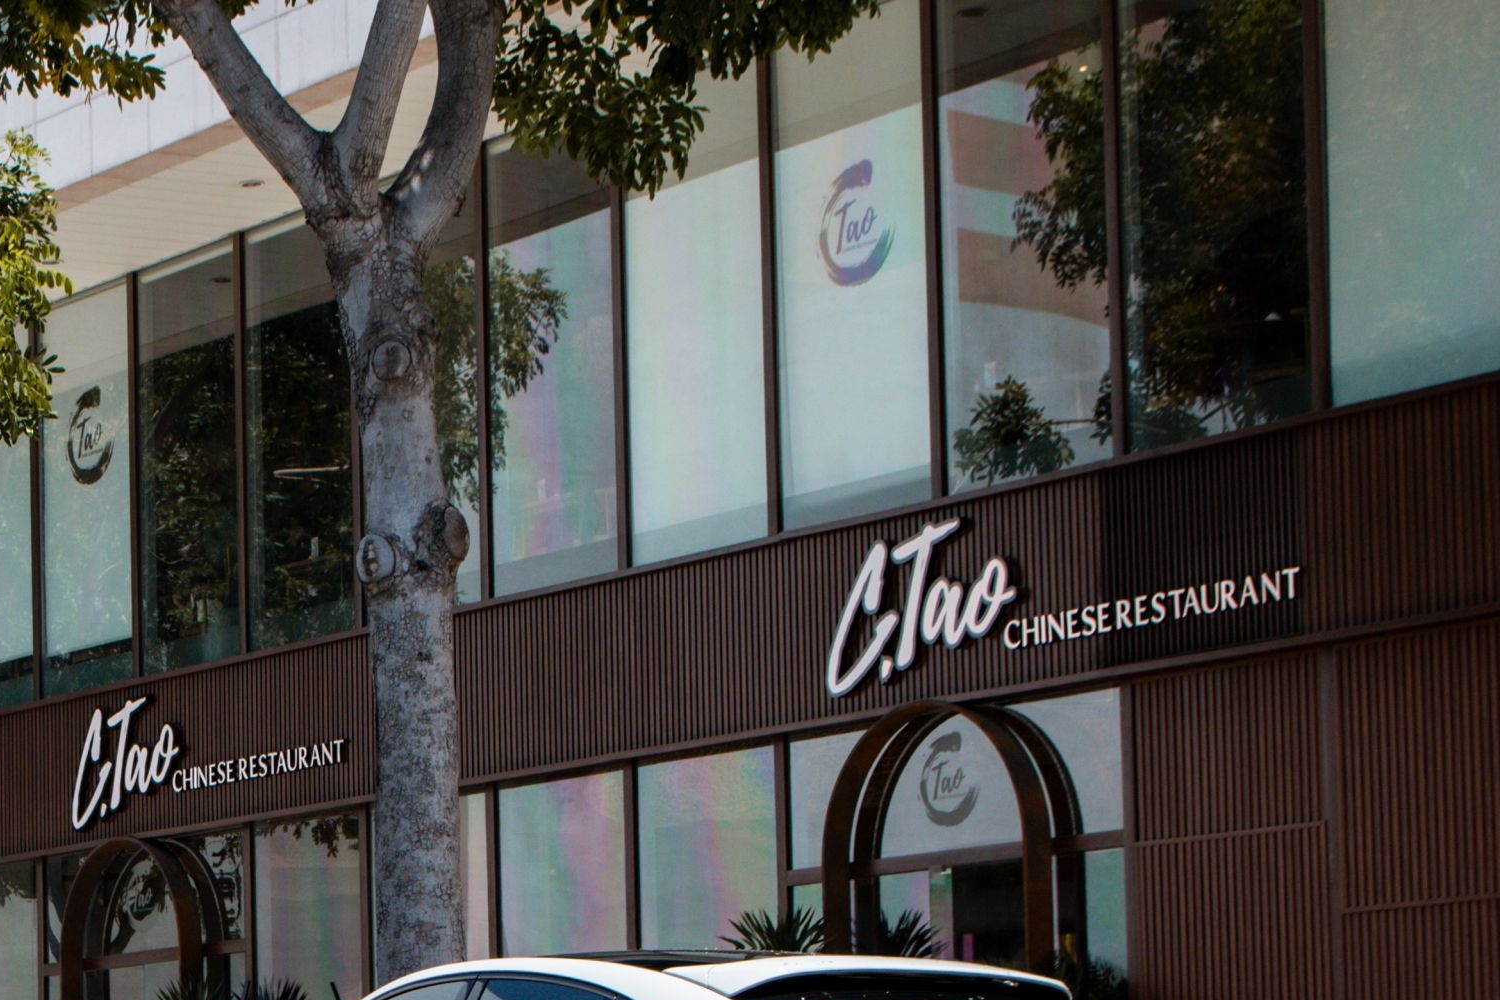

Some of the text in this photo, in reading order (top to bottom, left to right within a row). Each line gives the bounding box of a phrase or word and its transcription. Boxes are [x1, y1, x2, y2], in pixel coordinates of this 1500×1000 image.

[1003, 602, 1111, 651] CHINESE
[1114, 567, 1300, 631] RESTAURANT
[172, 760, 235, 793] CHINESE
[238, 740, 344, 781] RESTAURANT
